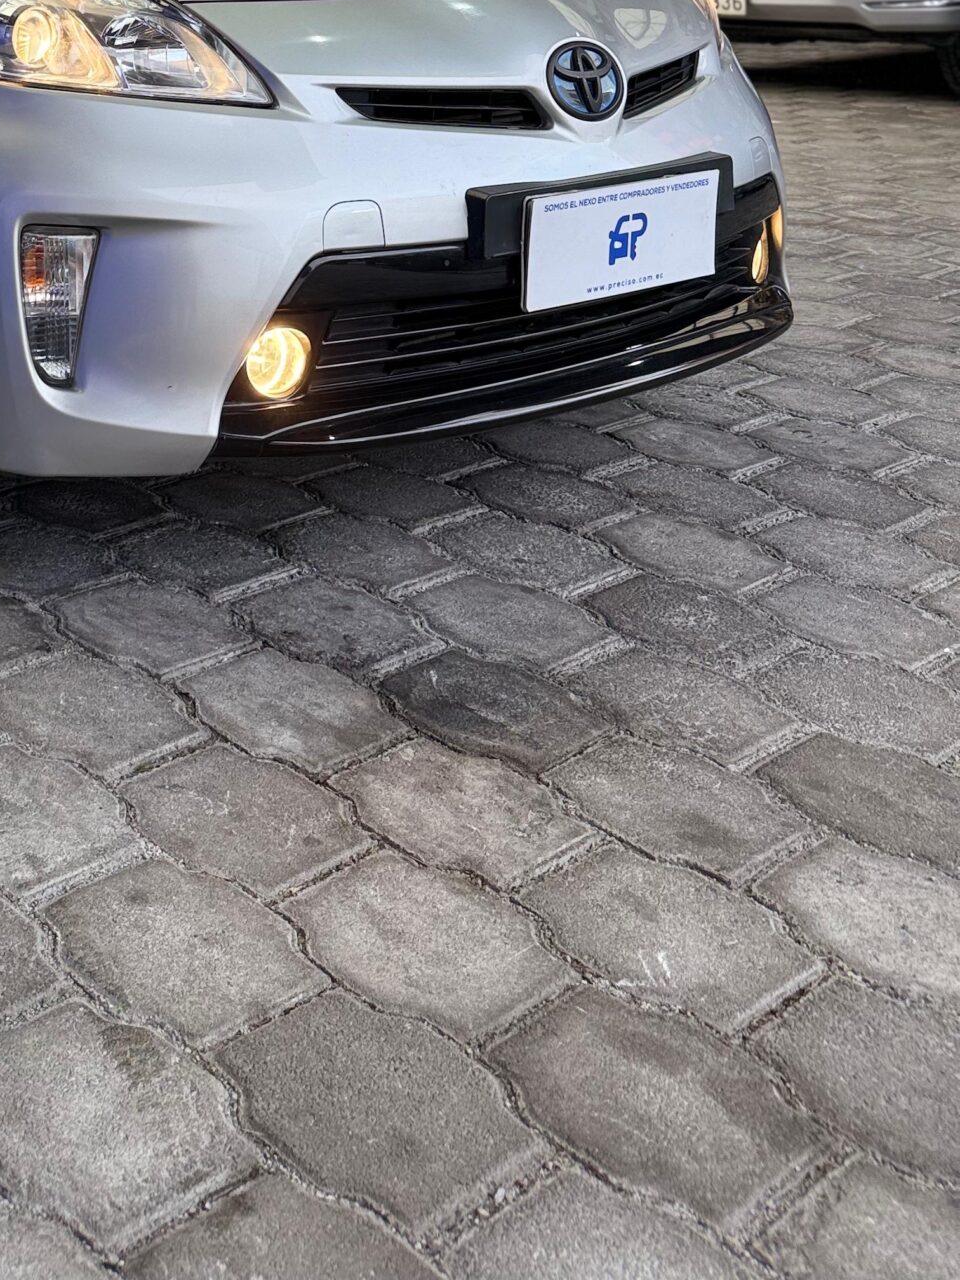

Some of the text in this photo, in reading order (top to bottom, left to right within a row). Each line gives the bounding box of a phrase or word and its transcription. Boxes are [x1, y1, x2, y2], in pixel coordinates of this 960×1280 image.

[544, 178, 709, 213] SOMOS EL NEXO ENTRE COMPRADORES Y VENDEDORES
